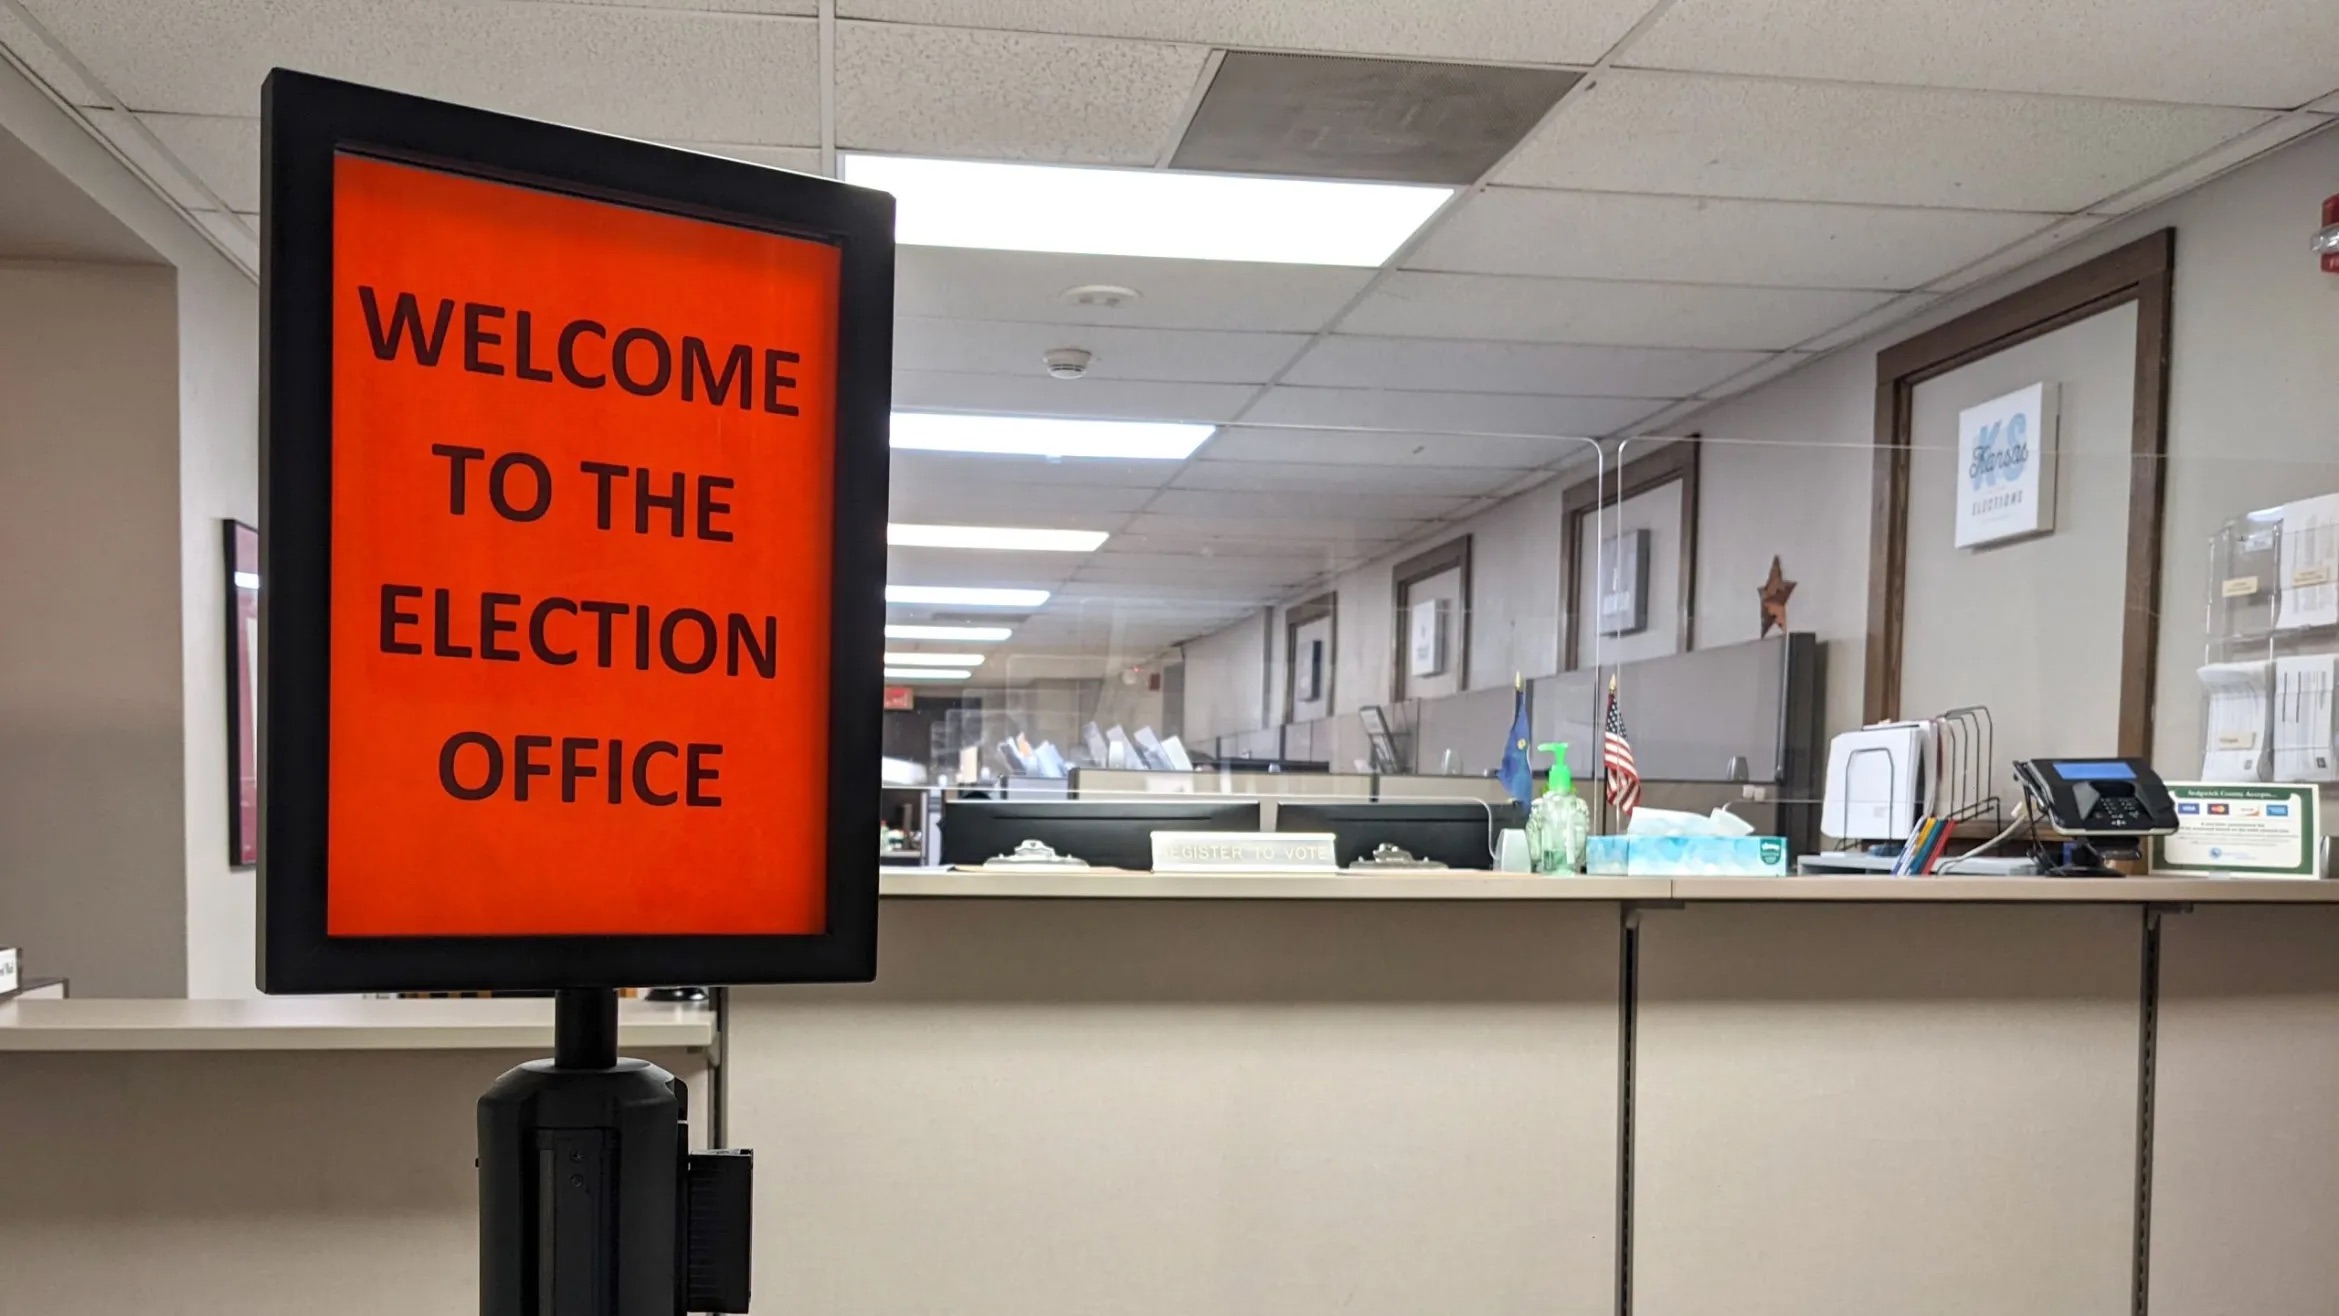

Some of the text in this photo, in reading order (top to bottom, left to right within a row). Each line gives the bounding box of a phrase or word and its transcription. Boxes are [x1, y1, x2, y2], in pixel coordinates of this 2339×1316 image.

[357, 285, 800, 417] WELCOME
[1969, 442, 2029, 479] Kansas
[1973, 412, 2027, 492] KS
[431, 442, 735, 543] TO THE
[1972, 489, 2023, 516] ELECTIONS
[379, 583, 778, 680] ELECTION
[438, 730, 724, 808] OFFICE
[1164, 845, 1328, 860] EGISTER TO VOTE
